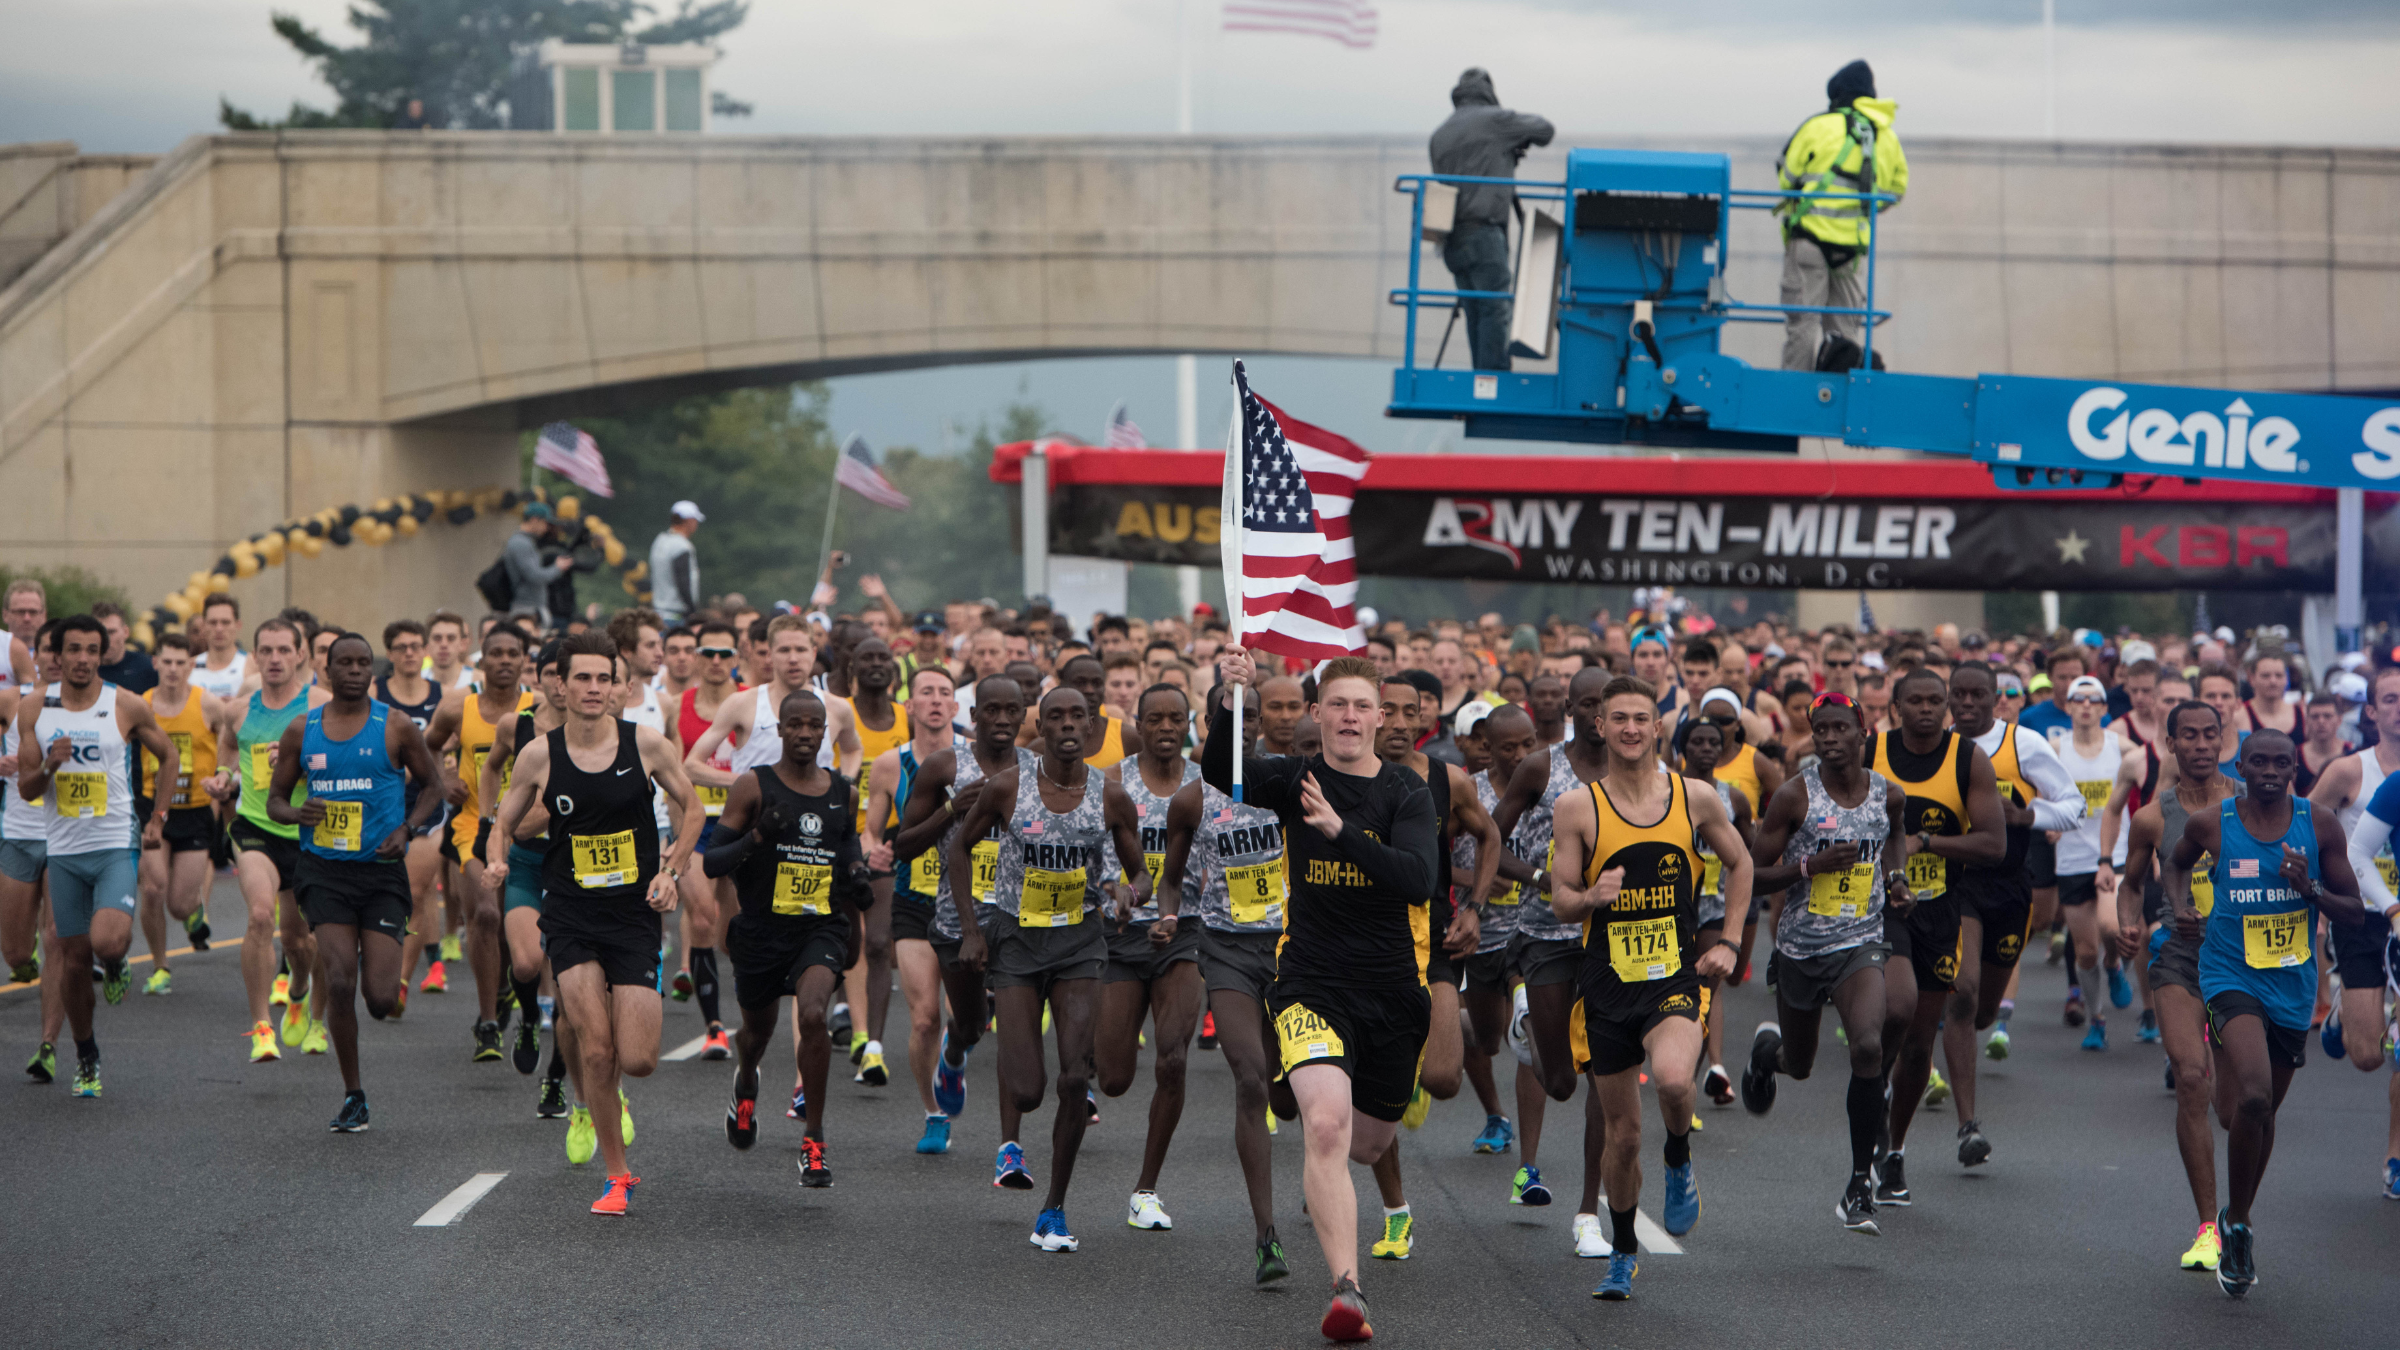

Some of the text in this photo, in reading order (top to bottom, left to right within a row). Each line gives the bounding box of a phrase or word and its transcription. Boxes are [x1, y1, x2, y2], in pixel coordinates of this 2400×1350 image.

[1116, 501, 1222, 544] AUS
[1423, 497, 1957, 571] ARMY TEN-MILER
[2119, 525, 2290, 568] KBR
[1824, 561, 1904, 588] D.C.
[70, 782, 89, 798] 20
[312, 777, 373, 792] FORT BRAGG
[325, 812, 348, 830] 179
[575, 840, 594, 849] ARMY
[596, 834, 632, 848] TEN-MILER
[1217, 822, 1284, 859] ARMY
[589, 846, 619, 865] 131
[777, 843, 791, 852] First
[792, 844, 817, 855] Infantry
[1023, 843, 1091, 870] ARMY
[787, 852, 829, 865] Running Team
[780, 867, 799, 876] ARMY
[1230, 870, 1250, 880] ARMY
[1662, 867, 1679, 876] MWR
[1909, 865, 1938, 882] 116
[791, 877, 820, 895] 507
[1026, 879, 1085, 893] ARMY TEN-MILER
[1256, 878, 1269, 896] 8
[1839, 876, 1850, 893] 6
[2192, 876, 2208, 885] ARM
[1050, 892, 1059, 908] 1
[2230, 888, 2301, 904] FORT BRAG
[1612, 926, 1632, 936] ARMY
[1635, 920, 1674, 935] TEN-MILER
[2248, 919, 2269, 929] ARMY
[2272, 913, 2307, 928] TEN-MILER
[1621, 932, 1668, 956] 1174
[2263, 926, 2295, 948] 157
[1284, 1013, 1329, 1042] 1240
[1294, 1037, 1306, 1046] AUSA
